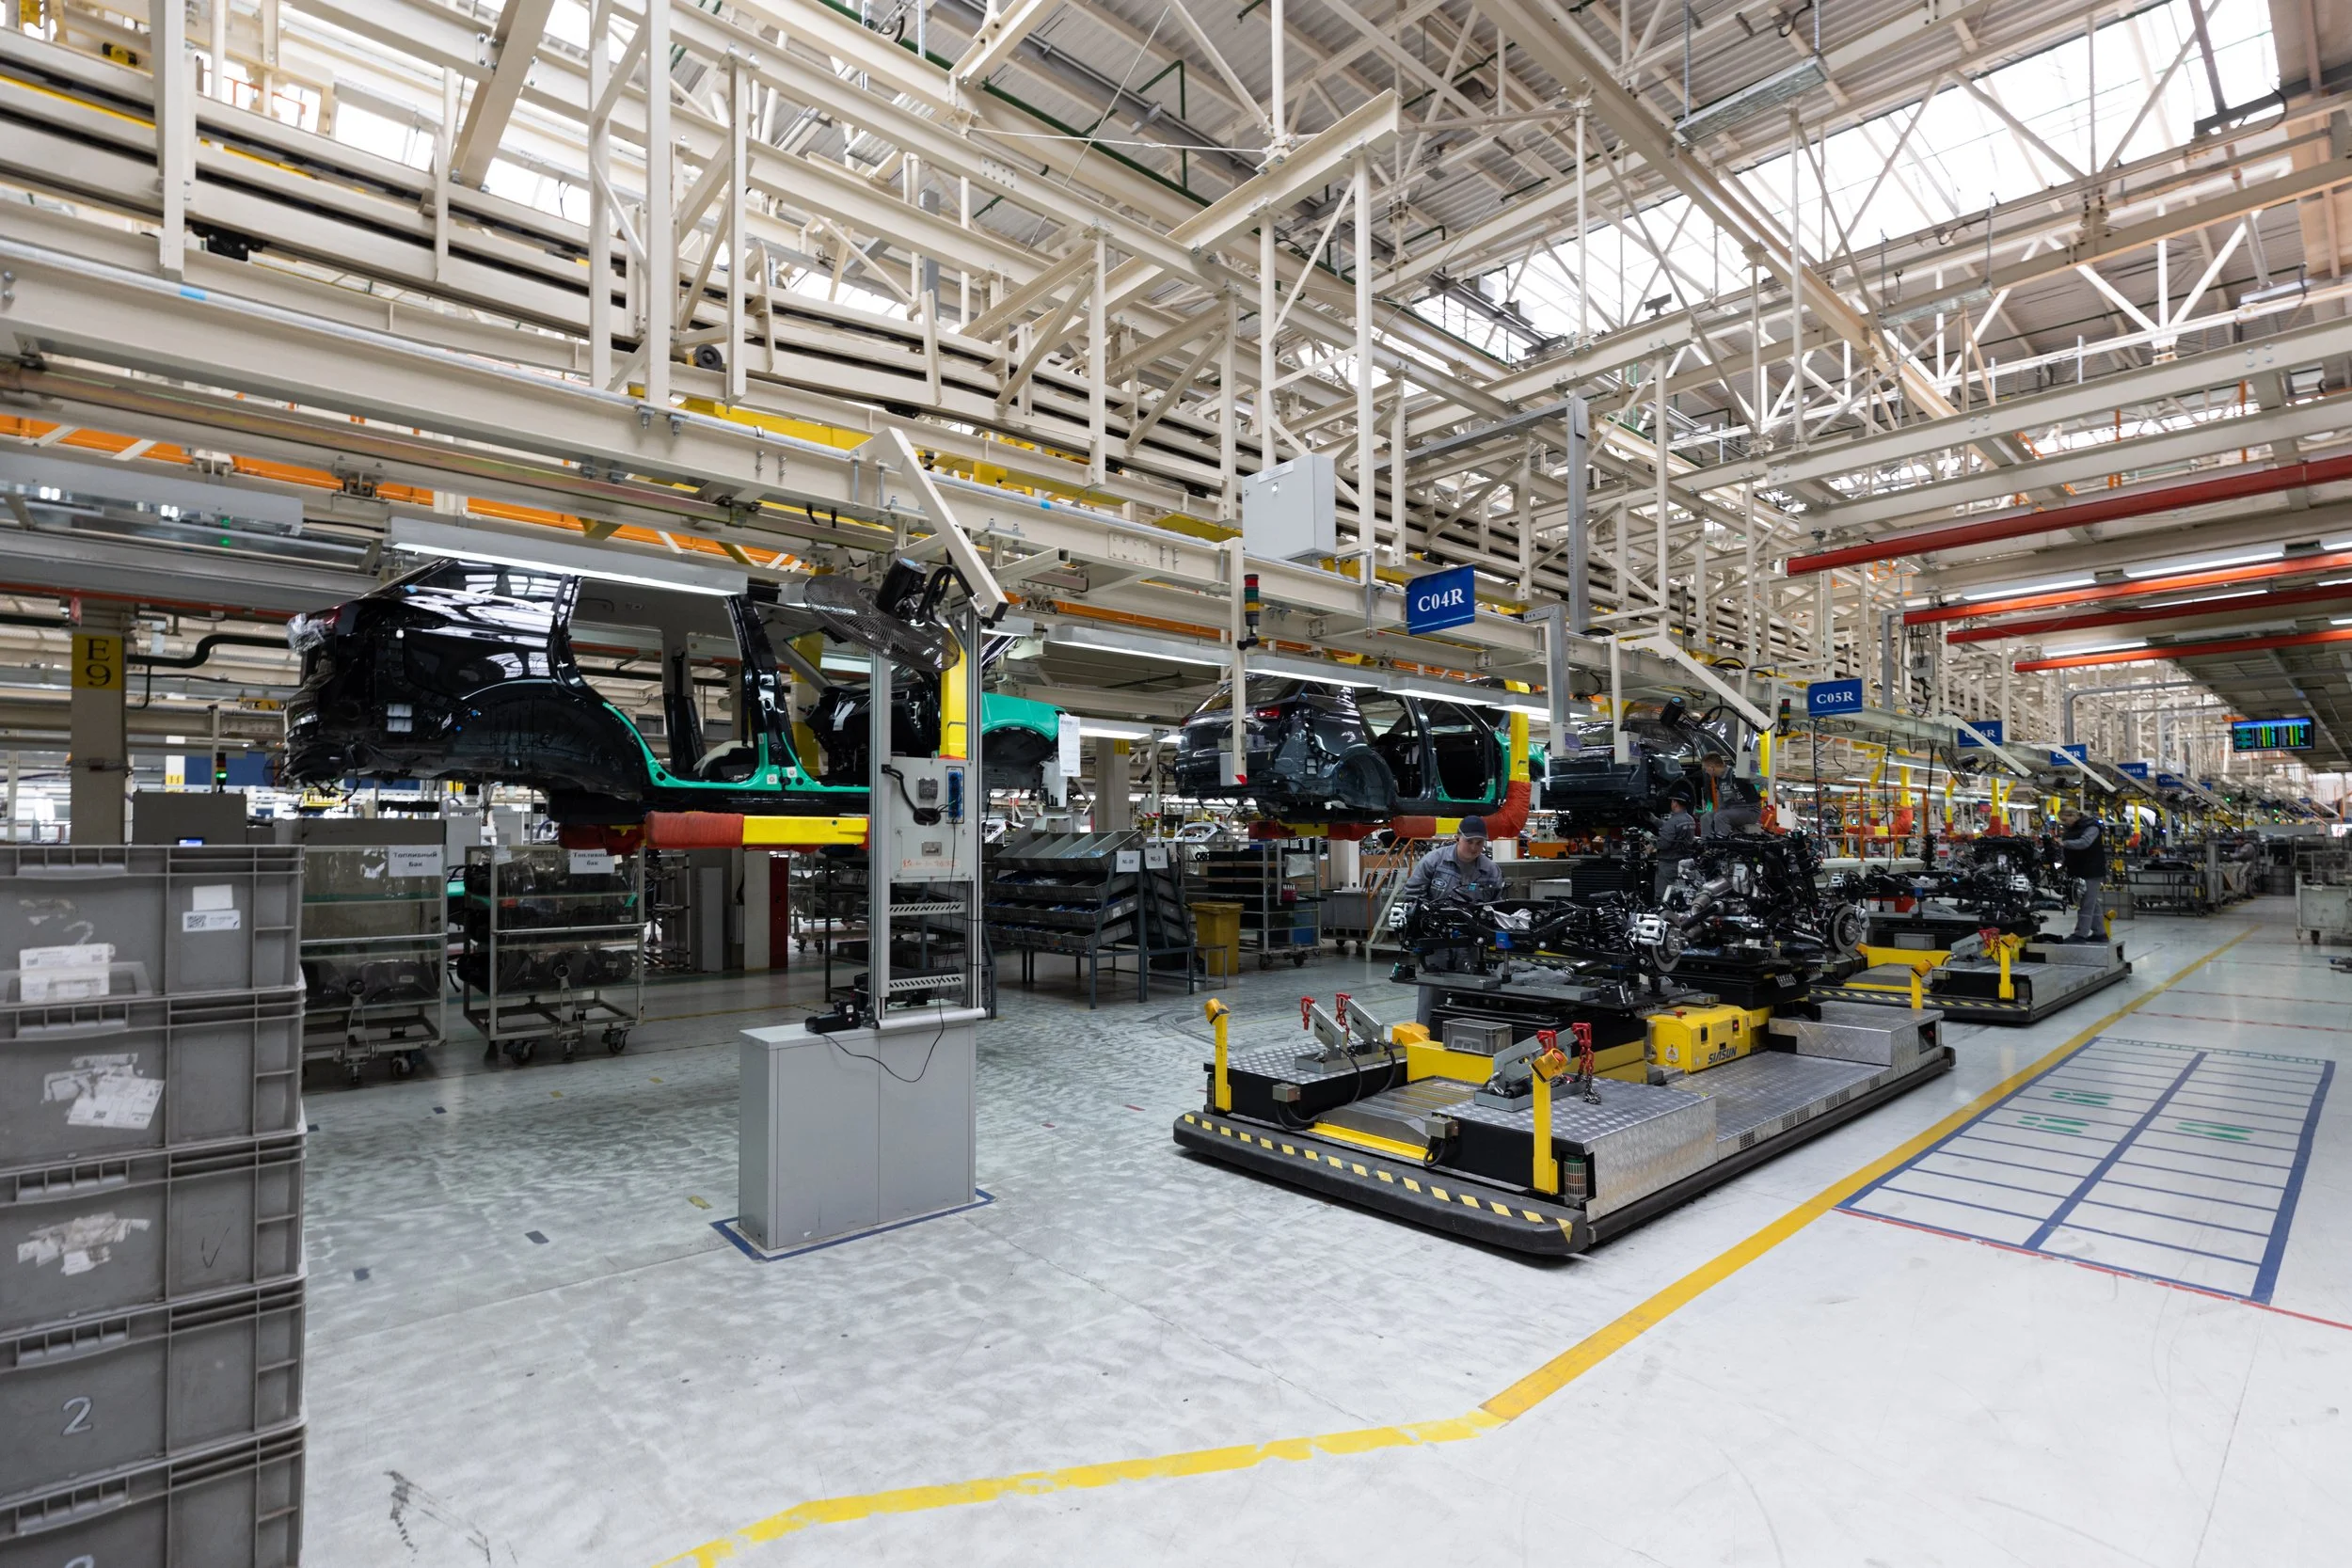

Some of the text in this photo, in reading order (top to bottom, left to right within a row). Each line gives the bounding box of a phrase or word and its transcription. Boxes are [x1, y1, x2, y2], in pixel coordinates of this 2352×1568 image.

[1418, 588, 1465, 612] C04R
[86, 637, 110, 662] E
[86, 663, 111, 688] 9
[1816, 691, 1854, 704] C05R
[1964, 729, 1996, 738] C6R
[2055, 751, 2081, 759] CR
[1708, 1046, 1738, 1064] SIASUN
[62, 1396, 93, 1436] 2
